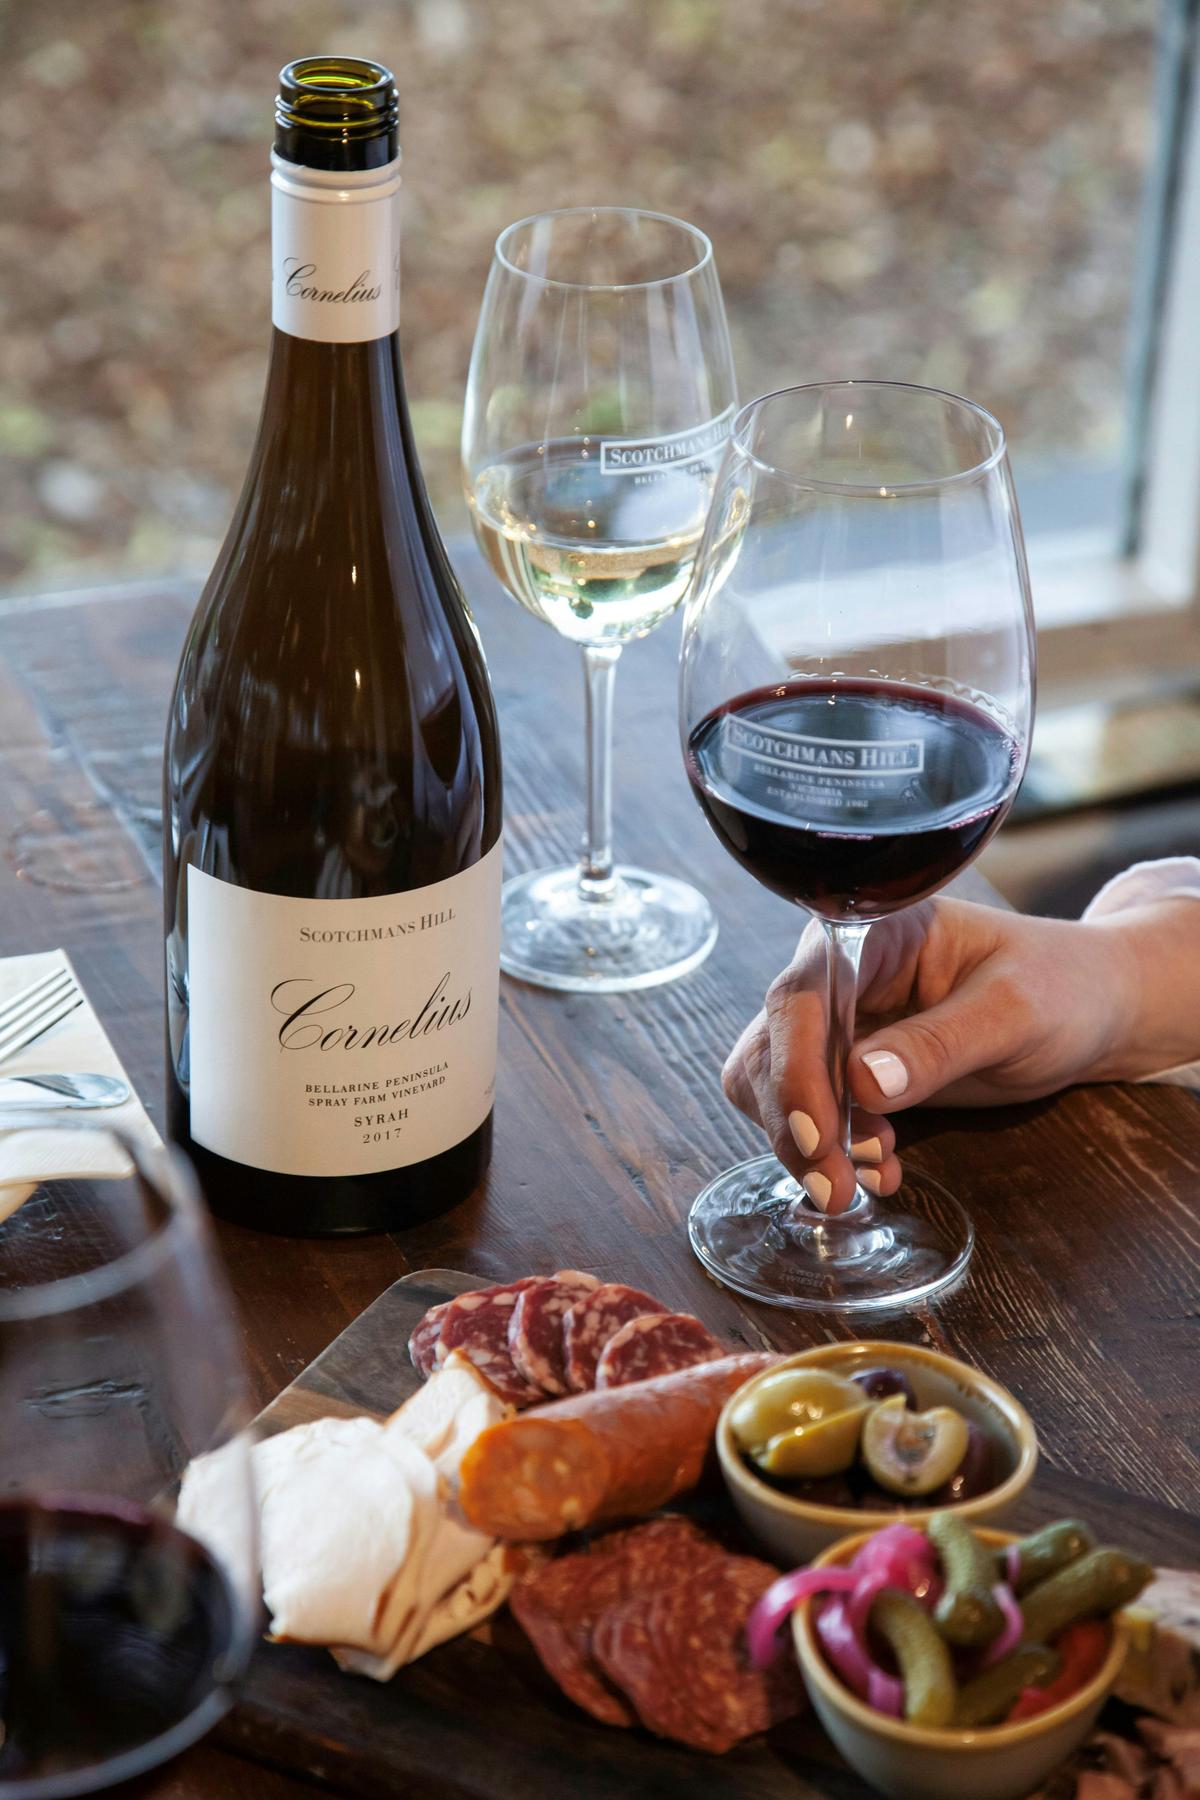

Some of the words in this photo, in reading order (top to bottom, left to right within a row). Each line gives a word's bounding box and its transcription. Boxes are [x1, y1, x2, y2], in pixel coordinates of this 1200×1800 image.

[282, 257, 382, 303] Cornelius
[734, 724, 855, 766] SCOTCHMANS
[860, 748, 912, 767] HILL
[300, 920, 416, 943] SCOTCHMANS
[420, 908, 456, 931] HILL
[270, 971, 473, 1053] Cornelius
[305, 1081, 379, 1094] BELLARINE
[385, 1061, 449, 1088] PENINSULA
[308, 1098, 348, 1107] SPRAY
[353, 1093, 386, 1106] FARM
[391, 1075, 446, 1100] VINEYARD
[354, 1108, 409, 1128] SYRAH
[363, 1128, 401, 1144] 2017
